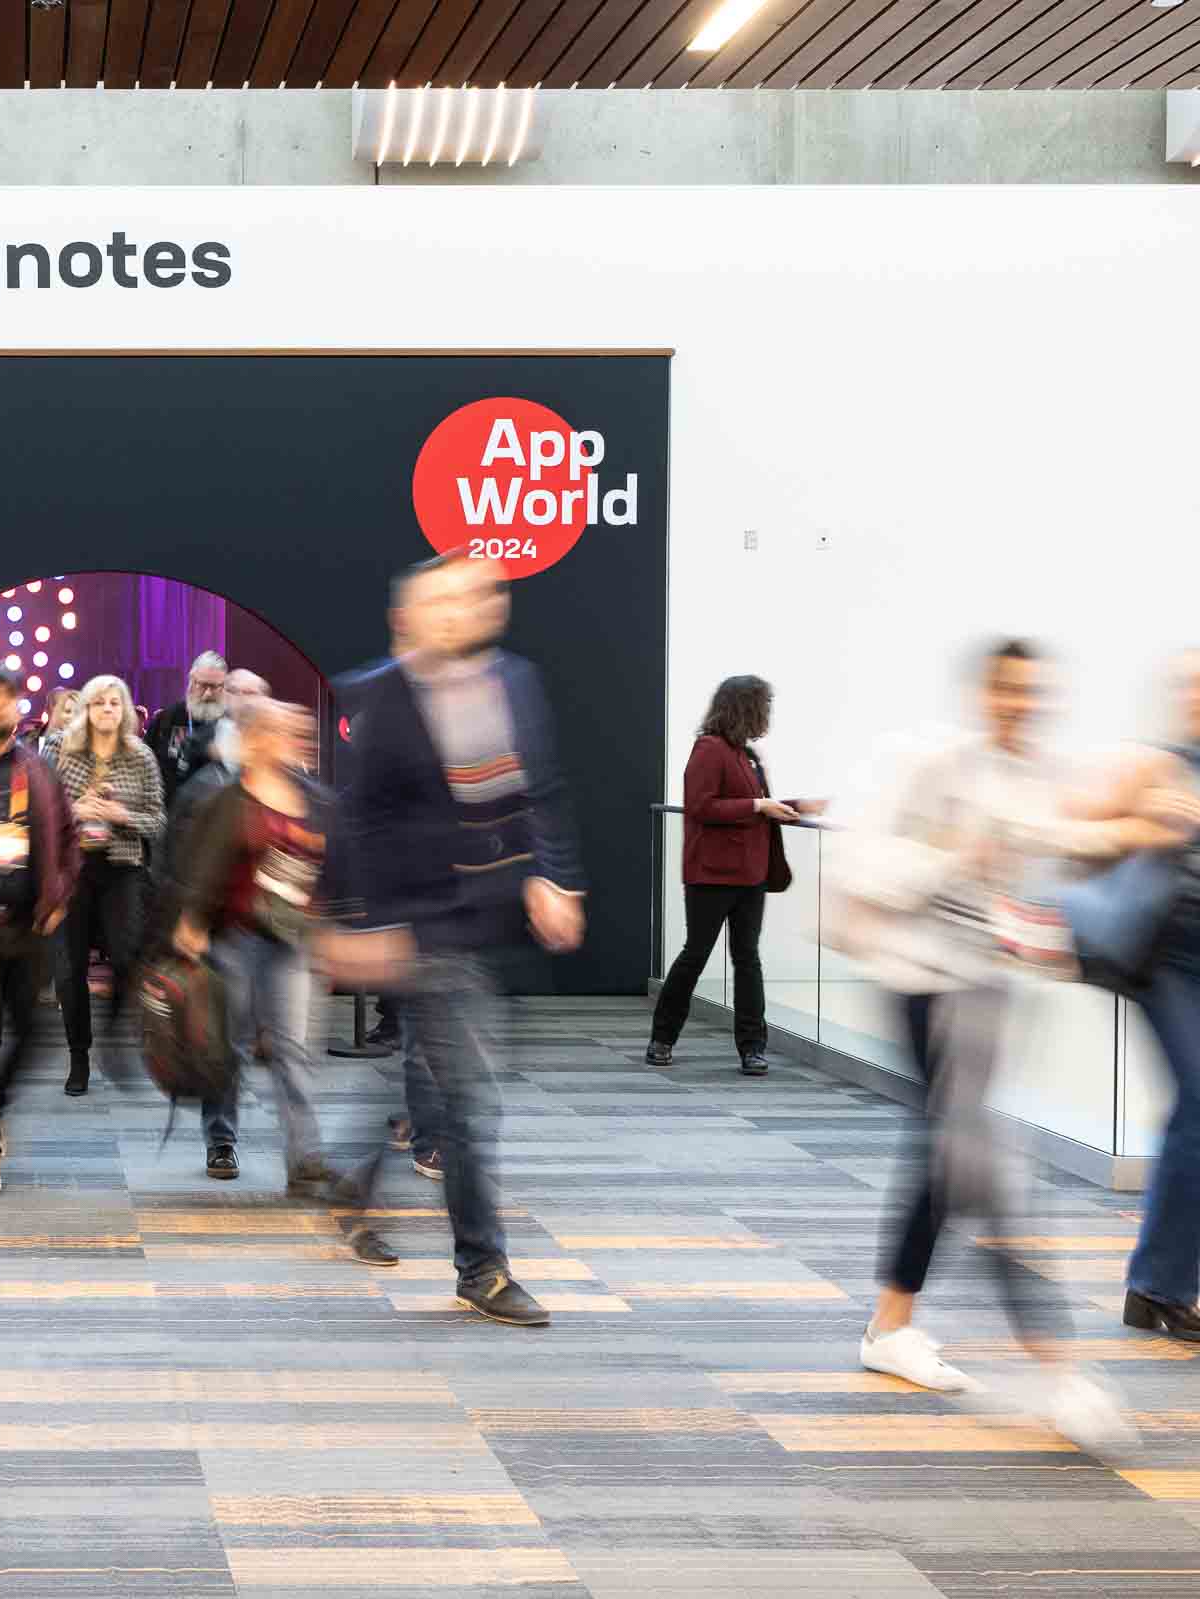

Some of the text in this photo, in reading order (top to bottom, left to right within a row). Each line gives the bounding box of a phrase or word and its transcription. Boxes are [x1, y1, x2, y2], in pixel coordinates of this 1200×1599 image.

[480, 418, 605, 481] App
[456, 472, 638, 526] World
[468, 537, 538, 559] 2024
